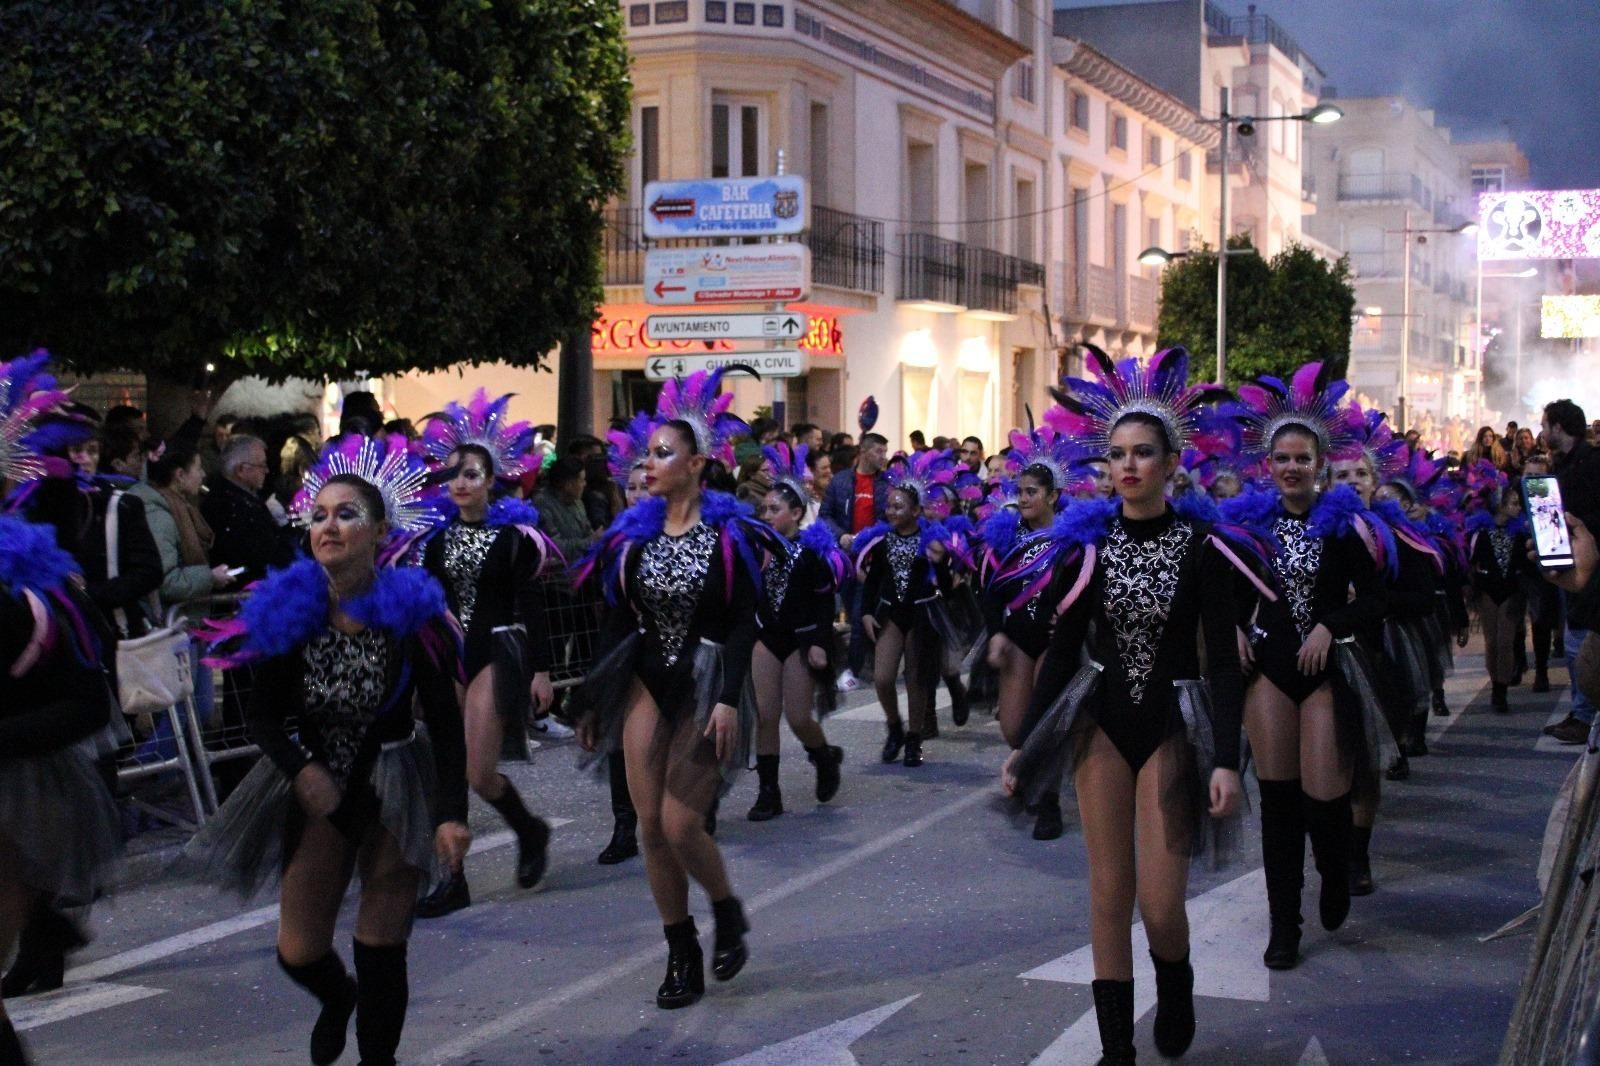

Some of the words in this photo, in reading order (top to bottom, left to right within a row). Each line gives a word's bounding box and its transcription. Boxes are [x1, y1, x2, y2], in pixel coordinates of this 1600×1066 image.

[722, 185, 749, 201] BAR
[700, 204, 772, 220] CAFETERIA
[654, 321, 730, 333] AYUNTAMIENTO
[764, 357, 795, 368] CIVIL
